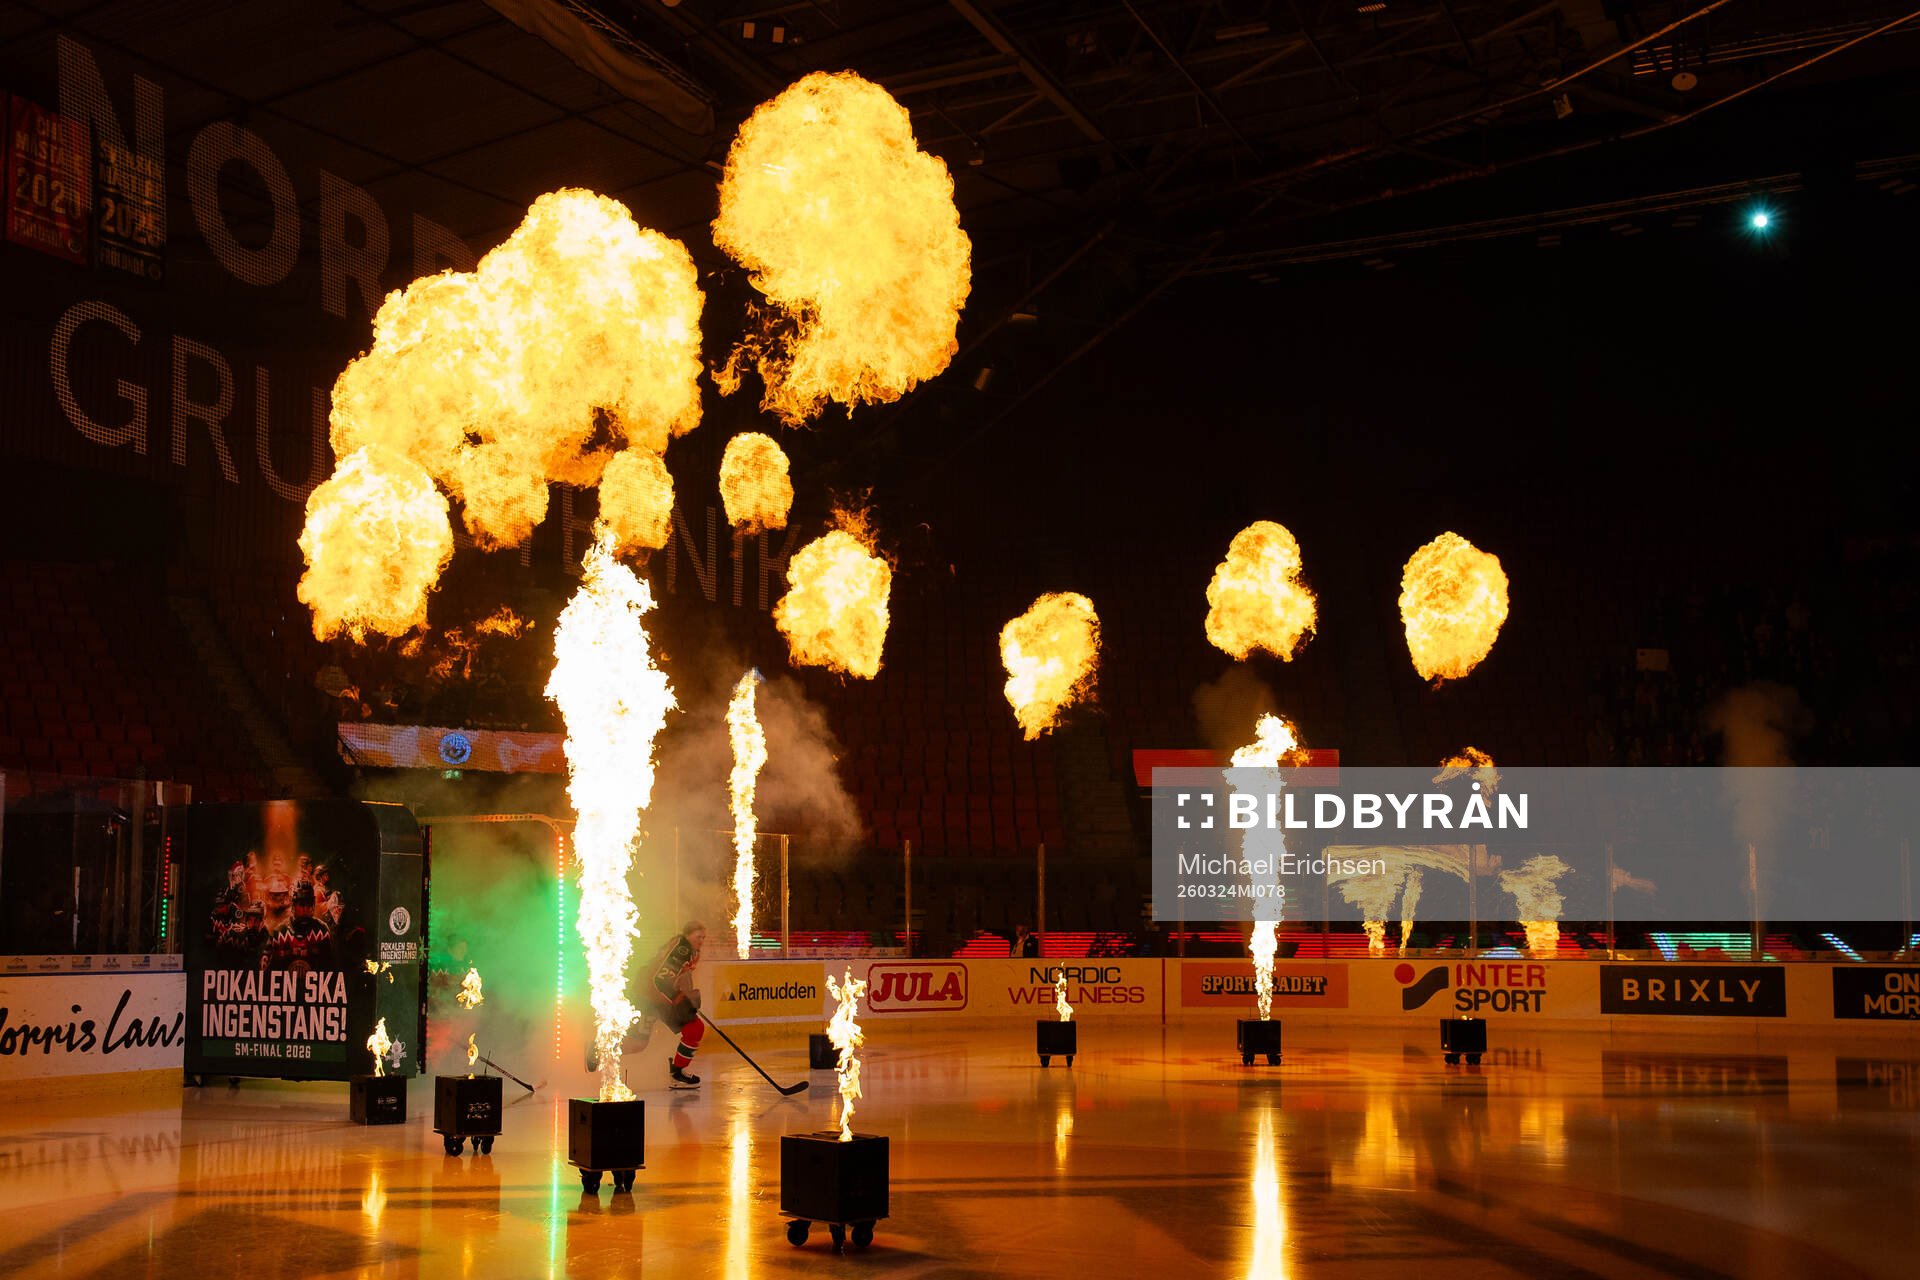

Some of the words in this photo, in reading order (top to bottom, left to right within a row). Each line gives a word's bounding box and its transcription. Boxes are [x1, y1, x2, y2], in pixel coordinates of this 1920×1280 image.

[203, 969, 298, 1003] POKALEN
[304, 971, 348, 1004] SKA
[871, 971, 964, 1003] JULA
[1202, 976, 1328, 995] SPORTADET
[1456, 963, 1546, 988] INTER
[738, 982, 816, 1001] Ramudden
[1008, 986, 1145, 1005] WELLNESS
[1455, 988, 1547, 1013] SPORT
[1622, 978, 1761, 1003] BRIXLY
[202, 1003, 347, 1042] INGENSTANS!
[235, 1042, 283, 1058] SM-FINAL
[286, 1044, 311, 1059] 2026
